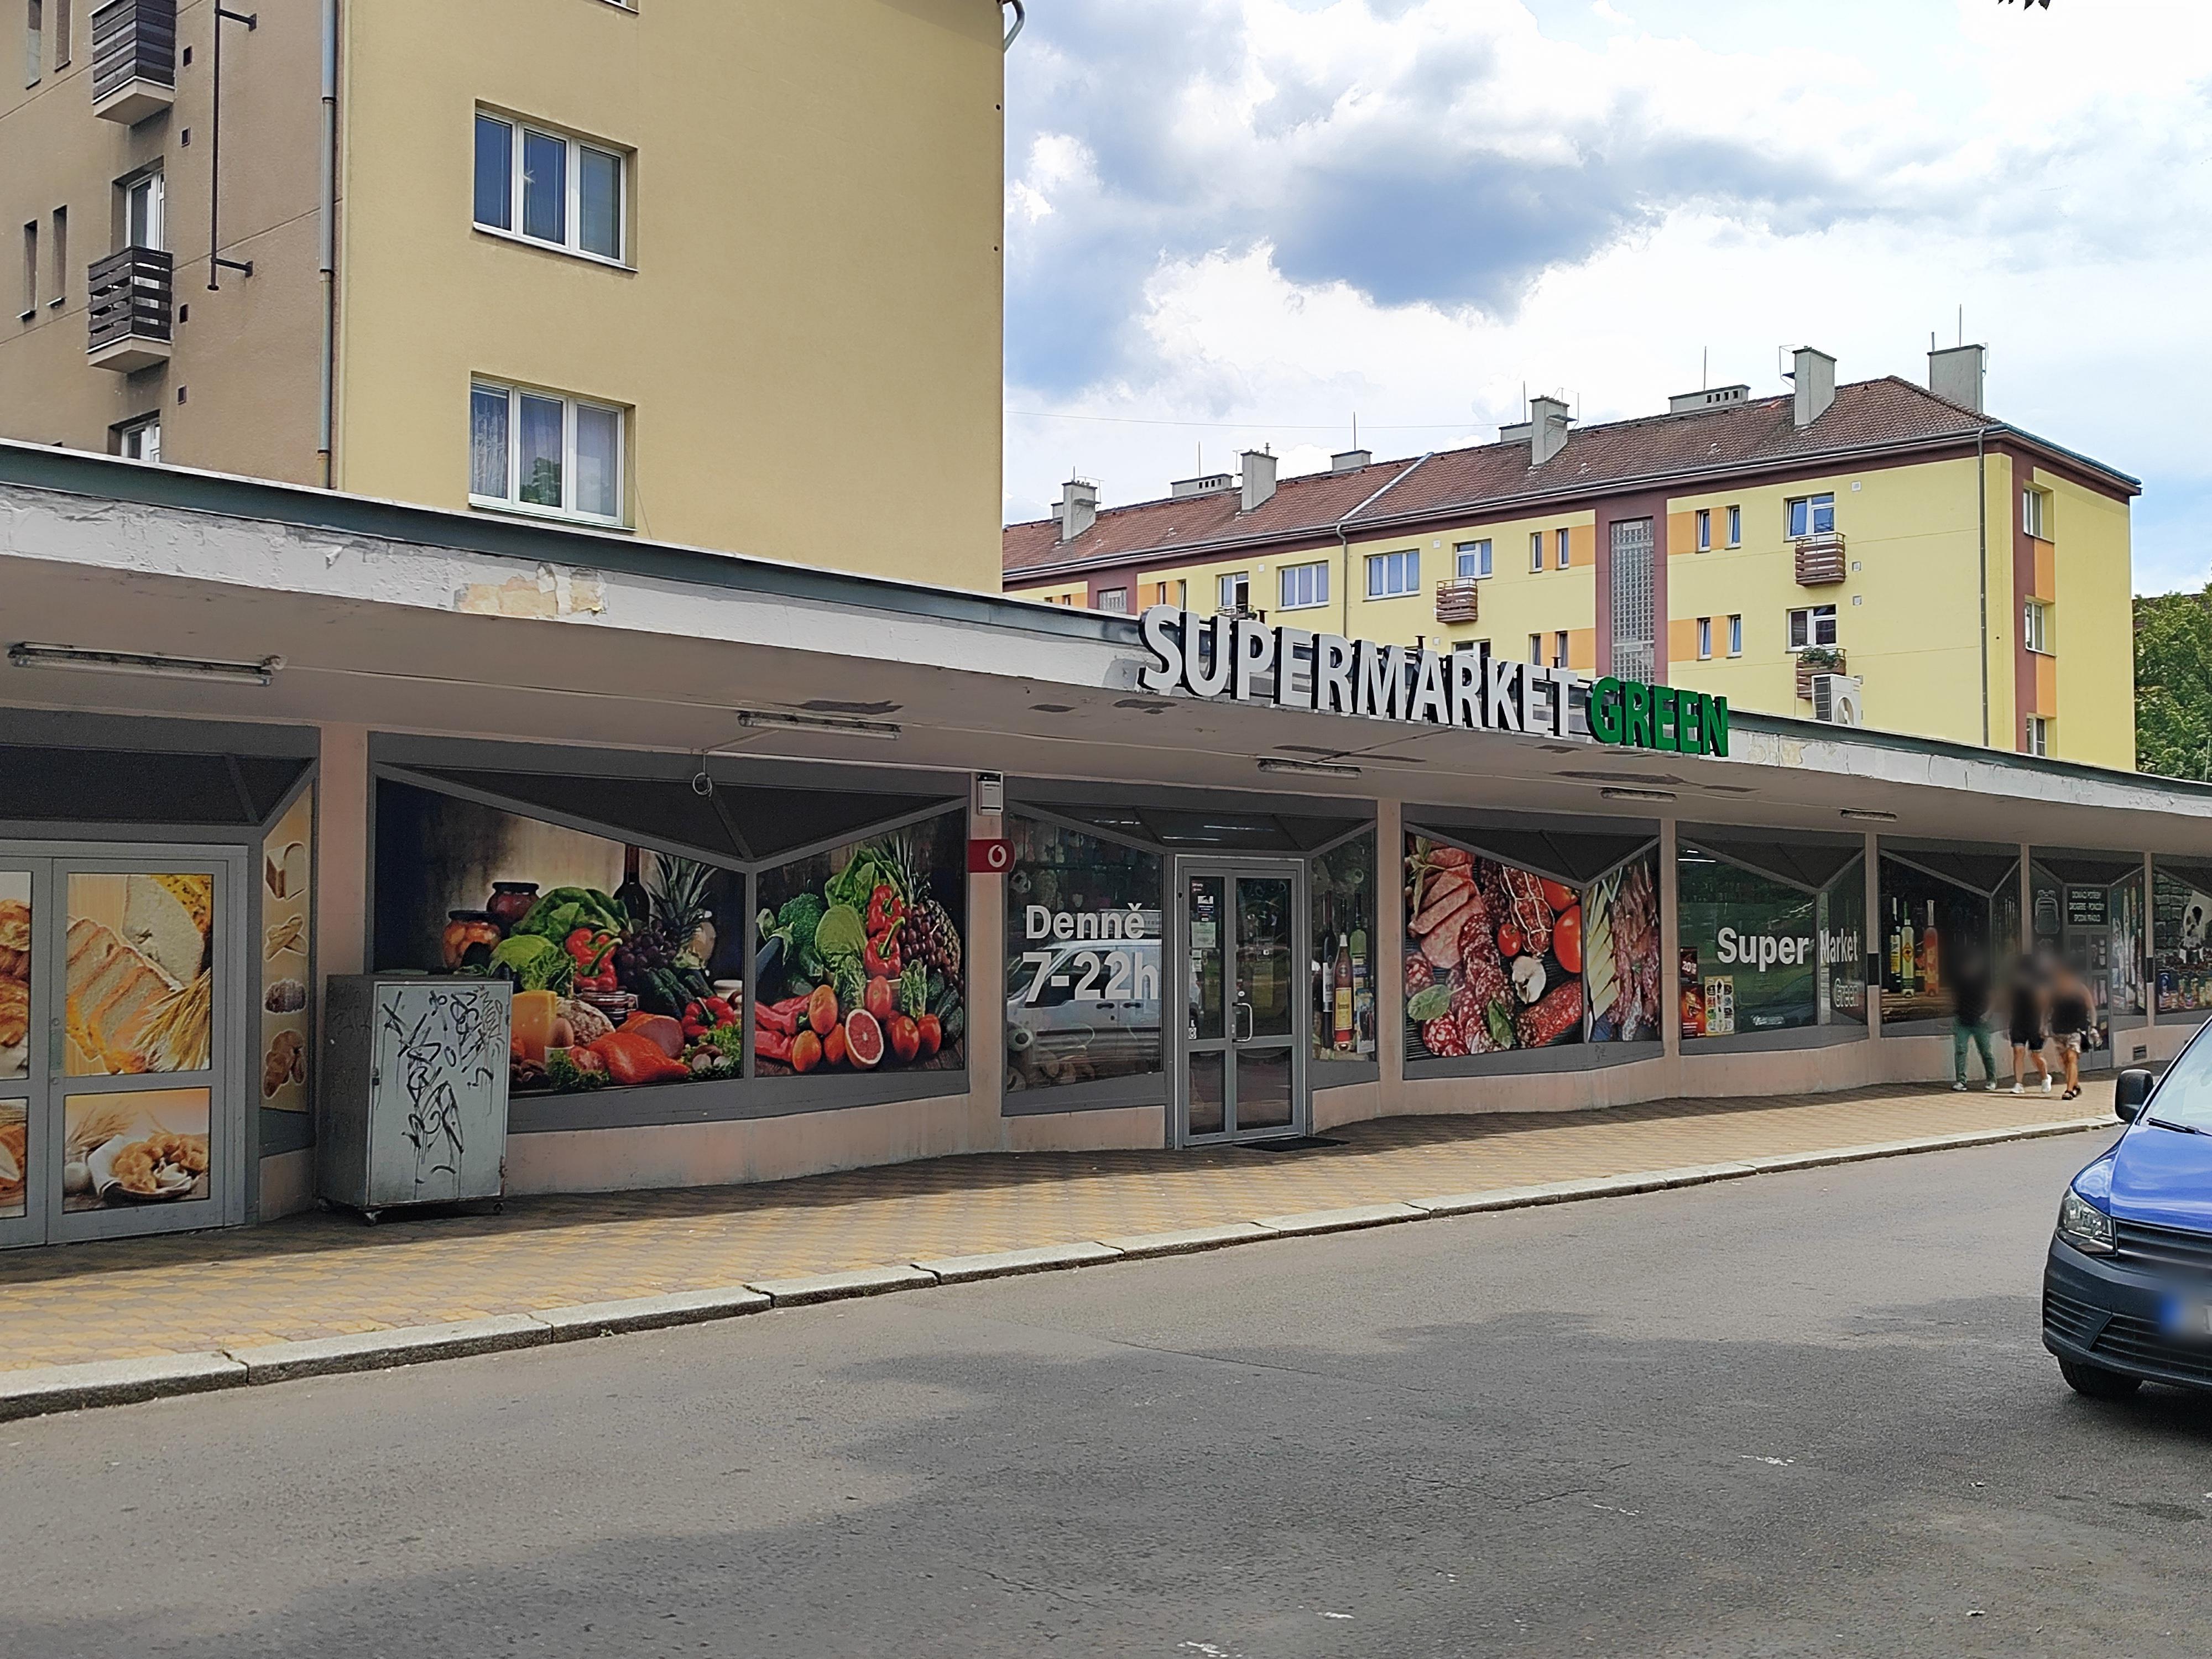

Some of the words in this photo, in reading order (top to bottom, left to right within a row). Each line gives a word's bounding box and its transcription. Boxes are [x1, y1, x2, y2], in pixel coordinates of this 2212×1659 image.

[1139, 604, 1578, 738] SUPERMARKET
[1586, 676, 1729, 758] GREEN
[1026, 902, 1145, 939] Denně
[1717, 927, 1809, 972] Super
[1820, 928, 1858, 964] Market
[1022, 951, 1159, 1002] 7-22h
[1833, 978, 1859, 1008] Green
